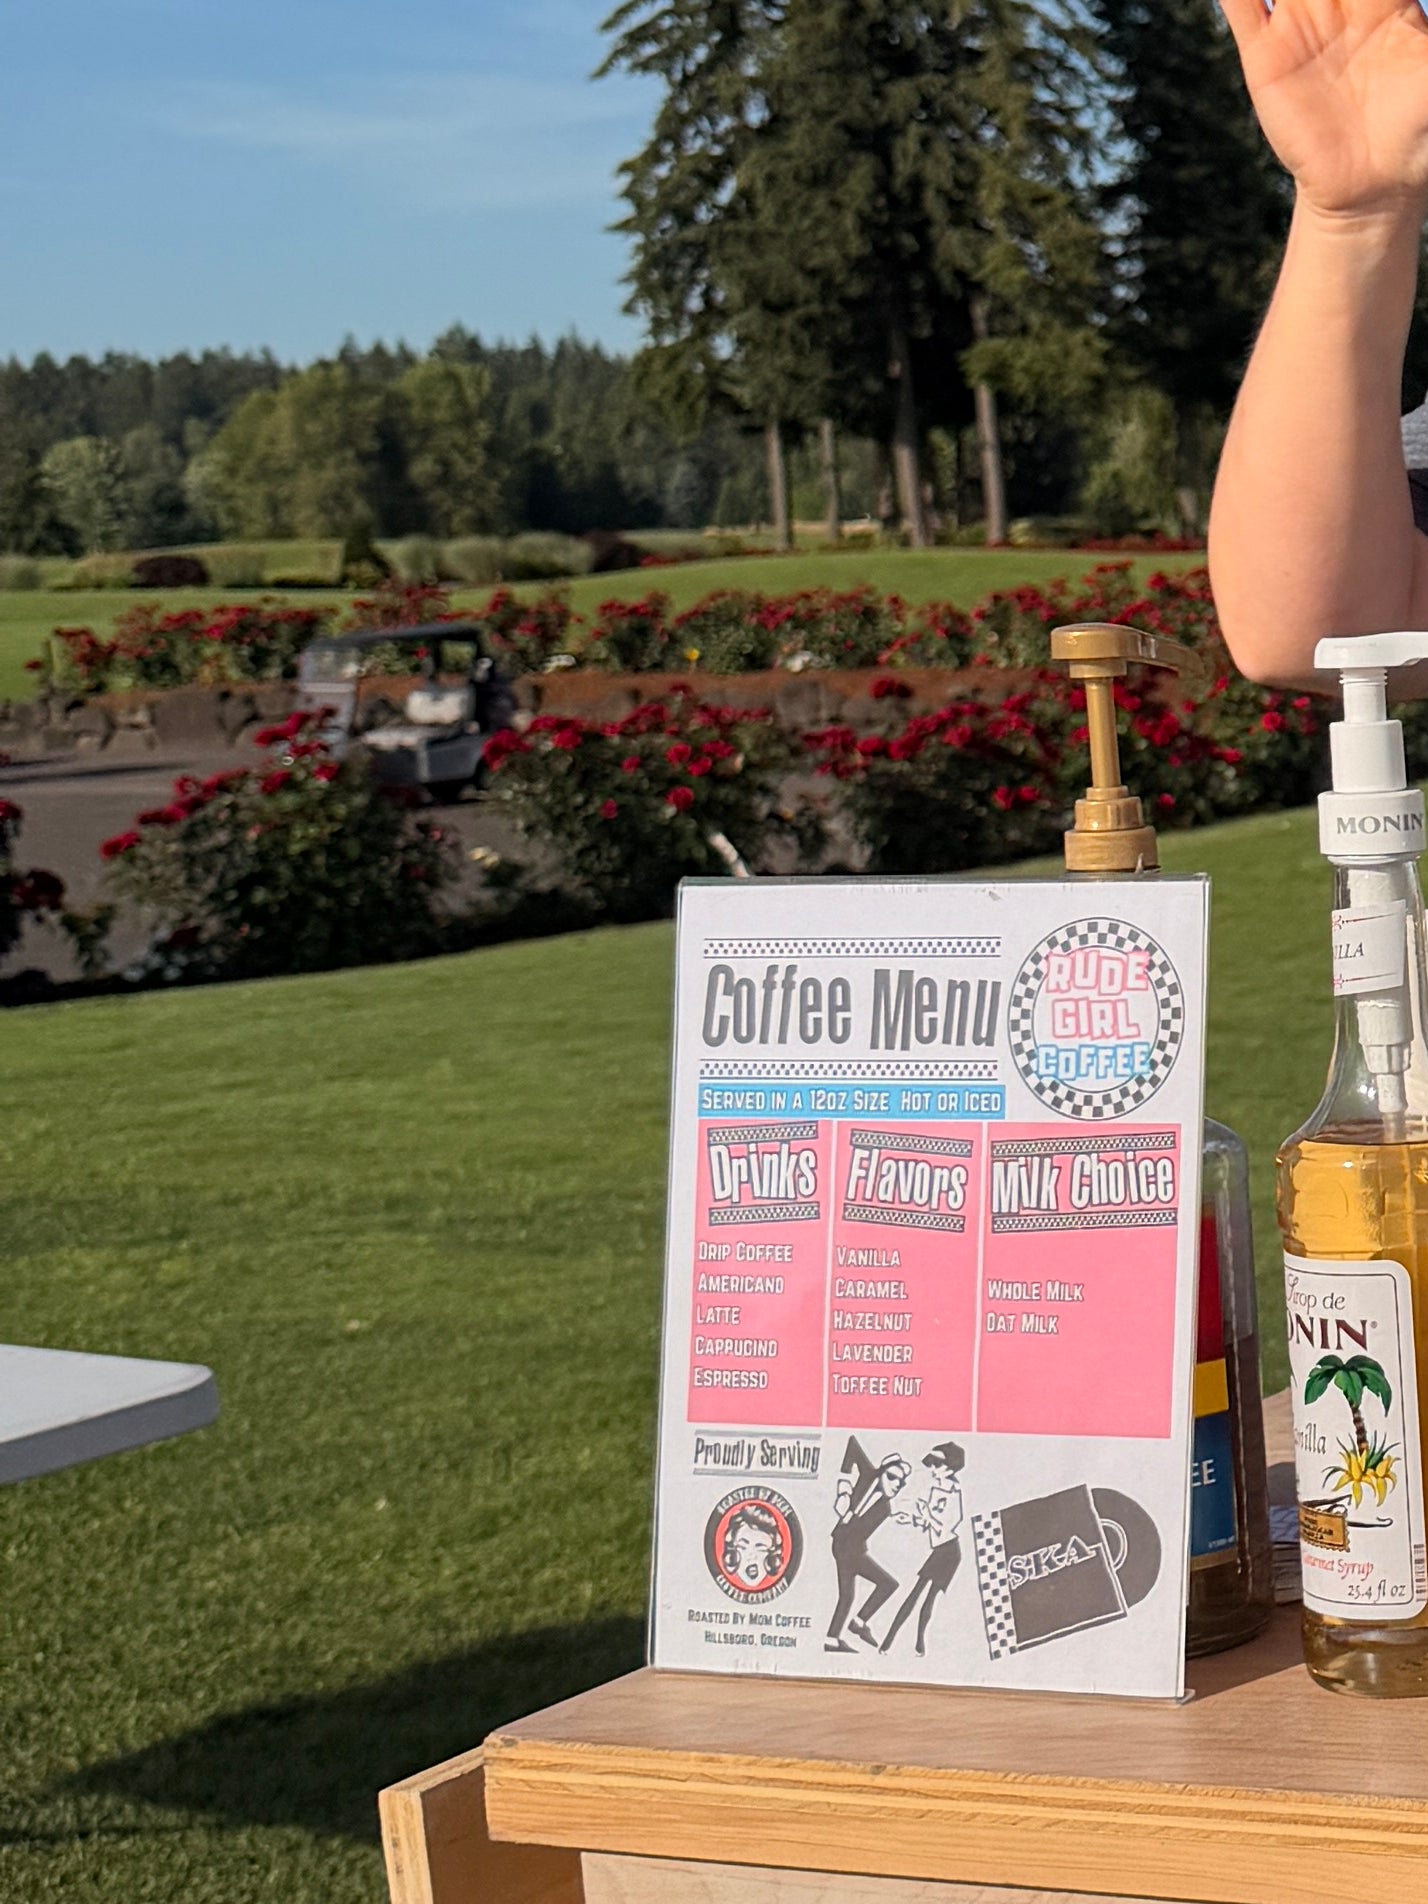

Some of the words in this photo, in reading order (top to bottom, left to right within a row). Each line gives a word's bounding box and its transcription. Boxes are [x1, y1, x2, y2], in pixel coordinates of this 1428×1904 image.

[1337, 813, 1423, 834] MONIN
[1045, 950, 1150, 995] RUDE
[702, 964, 851, 1047] Coffee
[870, 968, 1001, 1051] Menu
[1052, 999, 1140, 1040] GIRL
[1034, 1043, 1151, 1080] COFFEE
[771, 1092, 786, 1110] IN
[789, 1092, 803, 1110] A
[707, 1143, 818, 1204] Drinks
[845, 1147, 969, 1211] Flavors
[992, 1155, 1060, 1214] Milk
[1070, 1151, 1175, 1209] Choice
[836, 1245, 901, 1268] VANILLA
[697, 1273, 784, 1294] AMERICANO
[835, 1278, 908, 1300] CARAMEL
[987, 1279, 1041, 1301] WHOLE
[1046, 1280, 1084, 1302] MILK
[1322, 1293, 1346, 1311] de
[696, 1304, 741, 1325] LATTE
[833, 1310, 912, 1331] HAZELNUT
[986, 1312, 1015, 1333] OAT
[1021, 1313, 1059, 1334] MILK
[832, 1342, 913, 1363] LAVENDER
[693, 1367, 768, 1389] ESPRESSO
[832, 1373, 889, 1395] TOFFEE
[893, 1375, 922, 1396] NUT
[694, 1437, 756, 1470] Proudly
[760, 1438, 821, 1473] Serving
[1007, 1535, 1102, 1589] SKA
[1338, 1559, 1374, 1581] Syrup
[1348, 1584, 1373, 1597] 25.4
[1375, 1579, 1386, 1602] fl
[1390, 1584, 1406, 1597] oz
